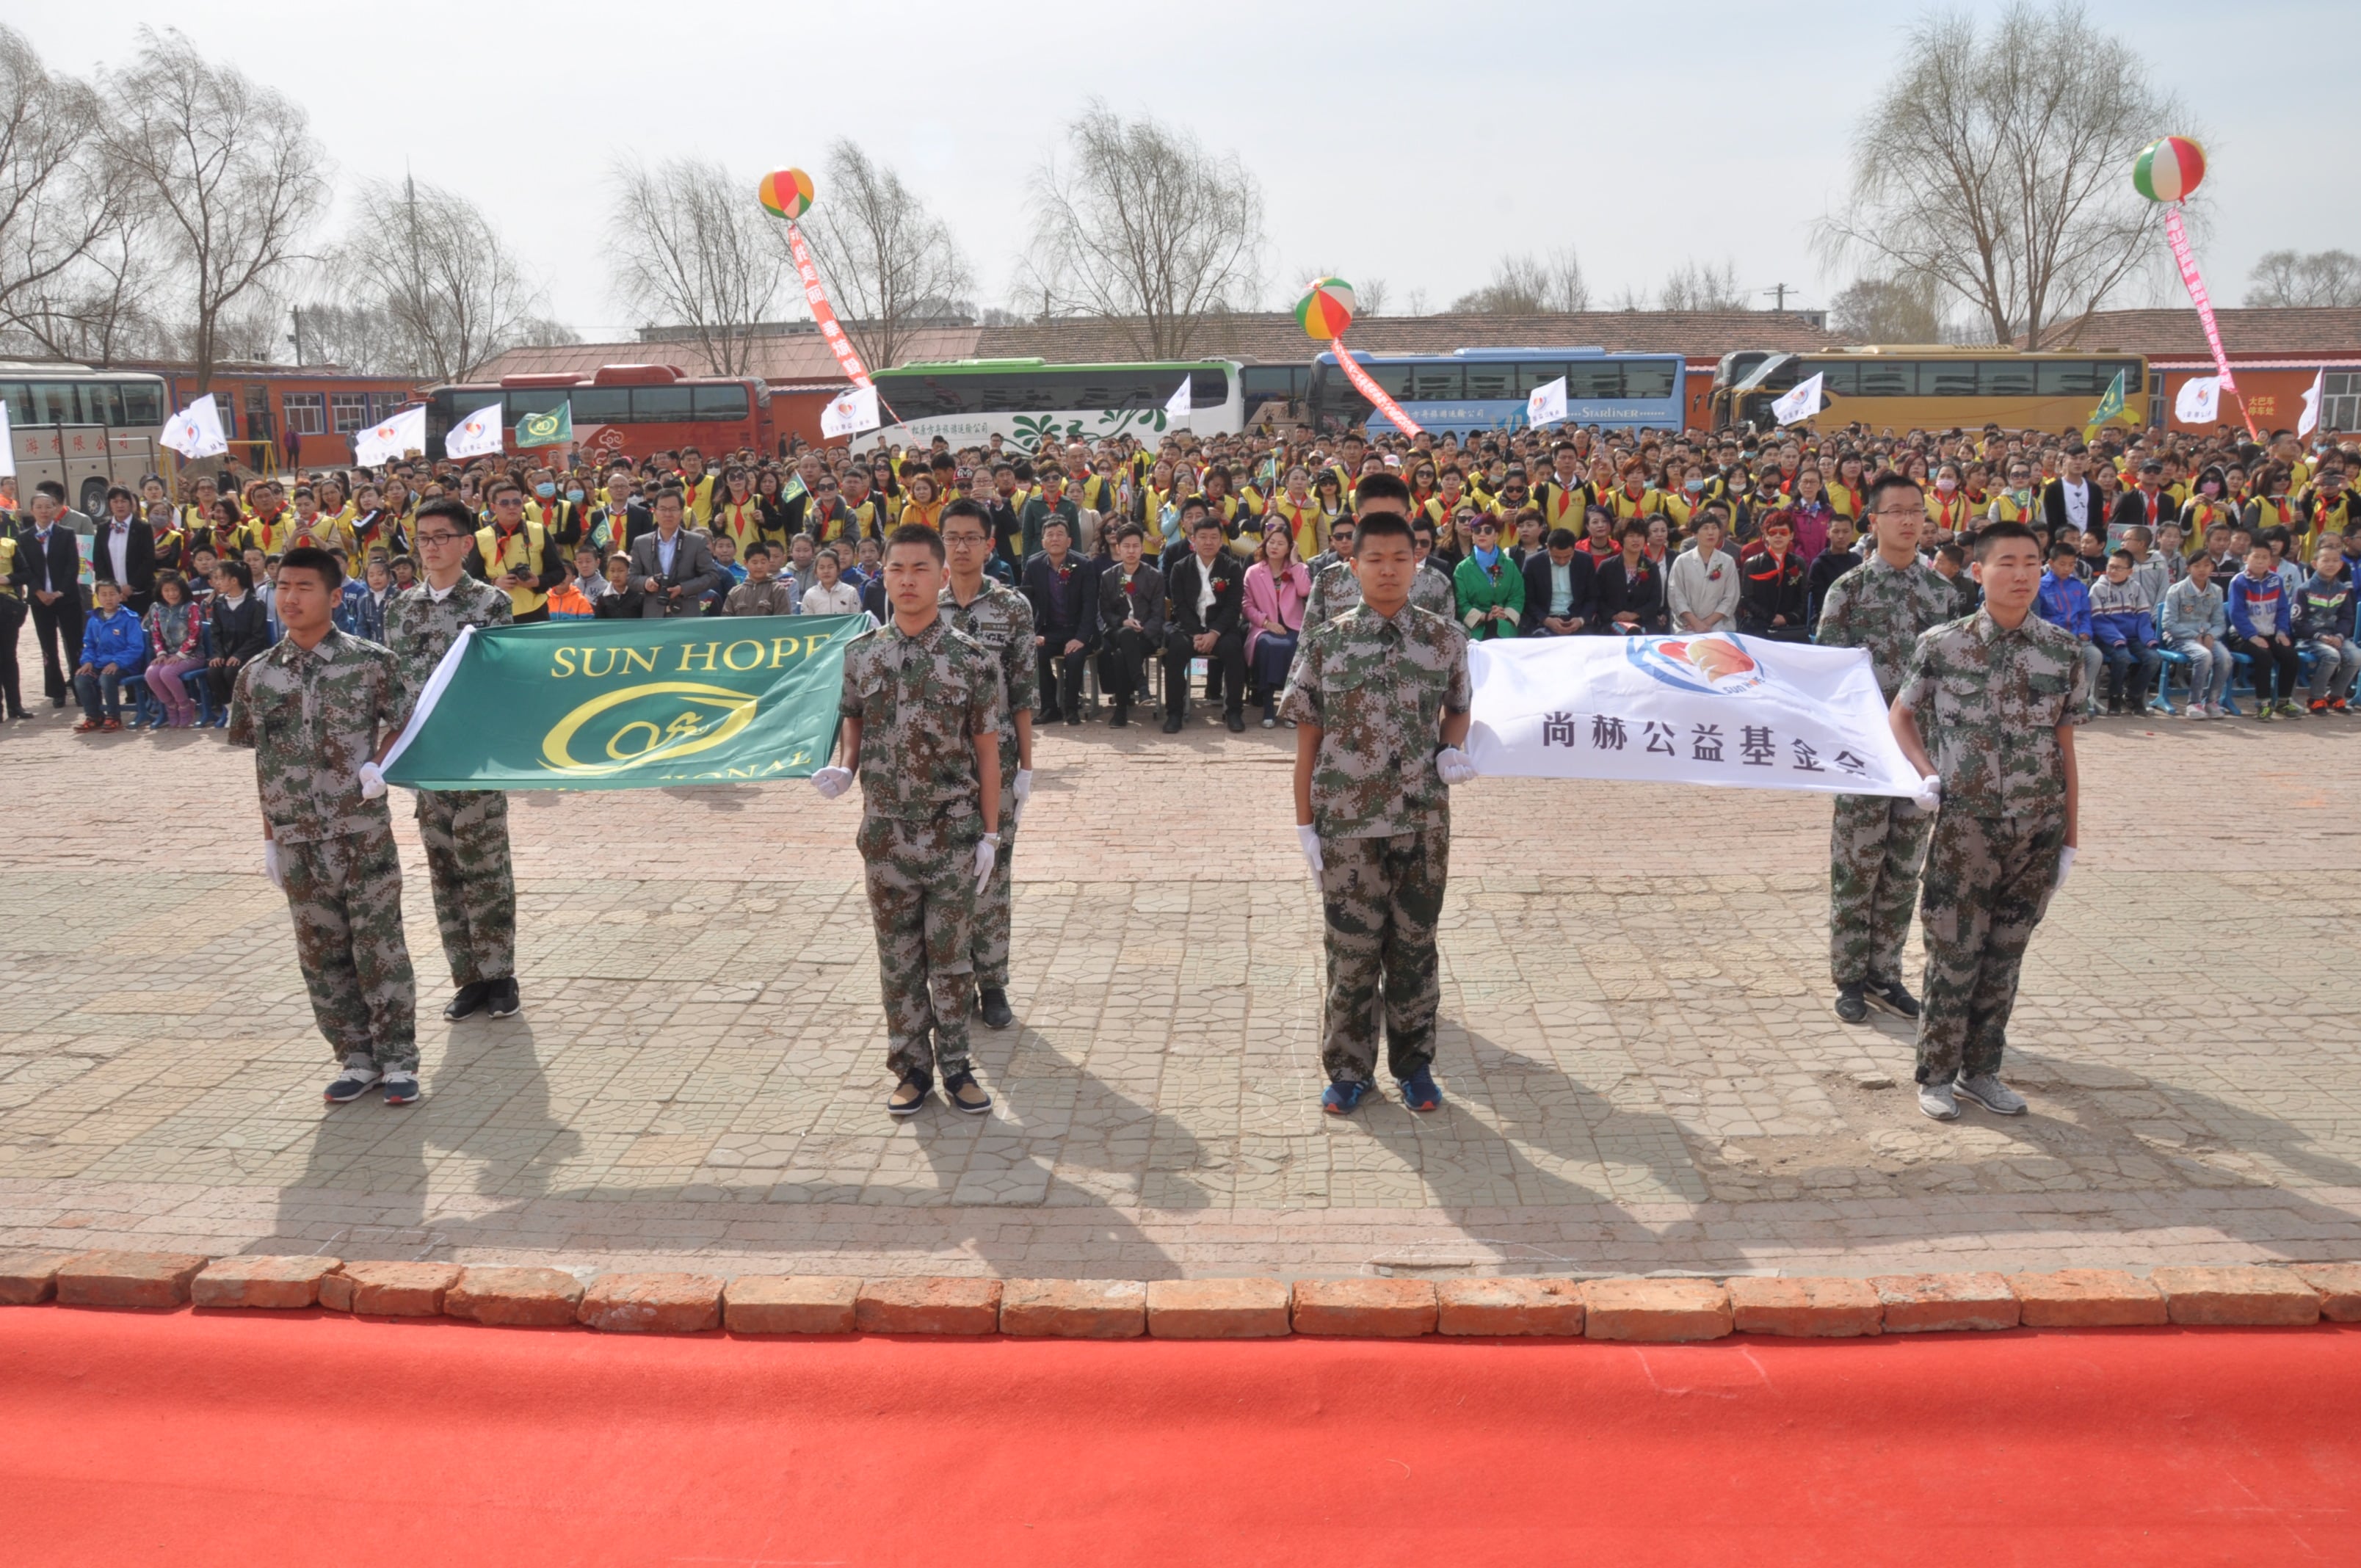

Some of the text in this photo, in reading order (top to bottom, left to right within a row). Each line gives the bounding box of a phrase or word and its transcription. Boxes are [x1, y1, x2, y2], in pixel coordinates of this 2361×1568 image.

[2249, 396, 2274, 405] 大巴车
[551, 634, 831, 678] SUN HOPE
[1543, 711, 1866, 776] 尚赫公益基金会
